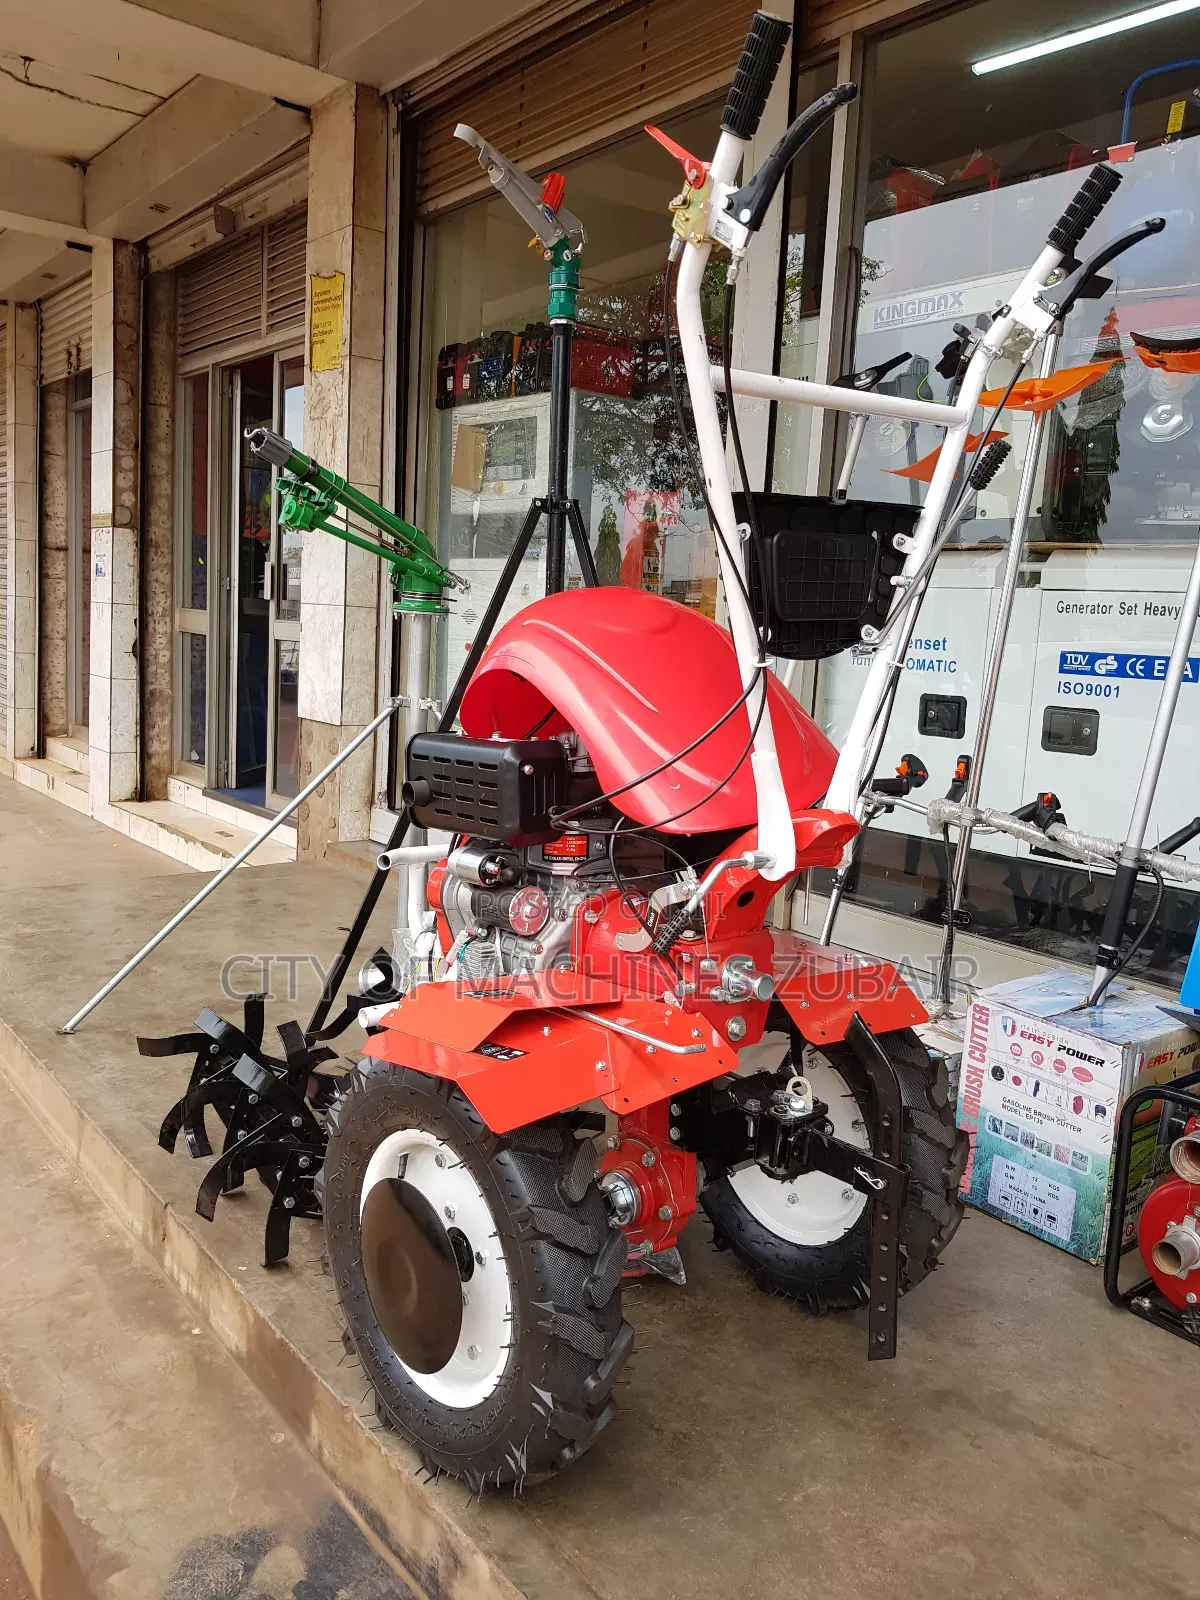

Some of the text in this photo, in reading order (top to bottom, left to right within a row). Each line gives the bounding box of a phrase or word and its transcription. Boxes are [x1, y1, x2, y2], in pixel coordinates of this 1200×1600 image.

[874, 291, 964, 322] KINGMAX
[1056, 600, 1181, 620] Generator Set Heavy
[1065, 653, 1090, 666] TÜV
[1057, 681, 1120, 699] ISO9001
[968, 1003, 990, 1064] CUTTER
[1020, 1030, 1054, 1048] EASY
[1057, 1044, 1106, 1068] POWER
[1146, 1049, 1177, 1069] EASY
[962, 1064, 985, 1119] BRUSH
[1002, 1096, 1082, 1134] GASOLINE BRUSH CUTTER
